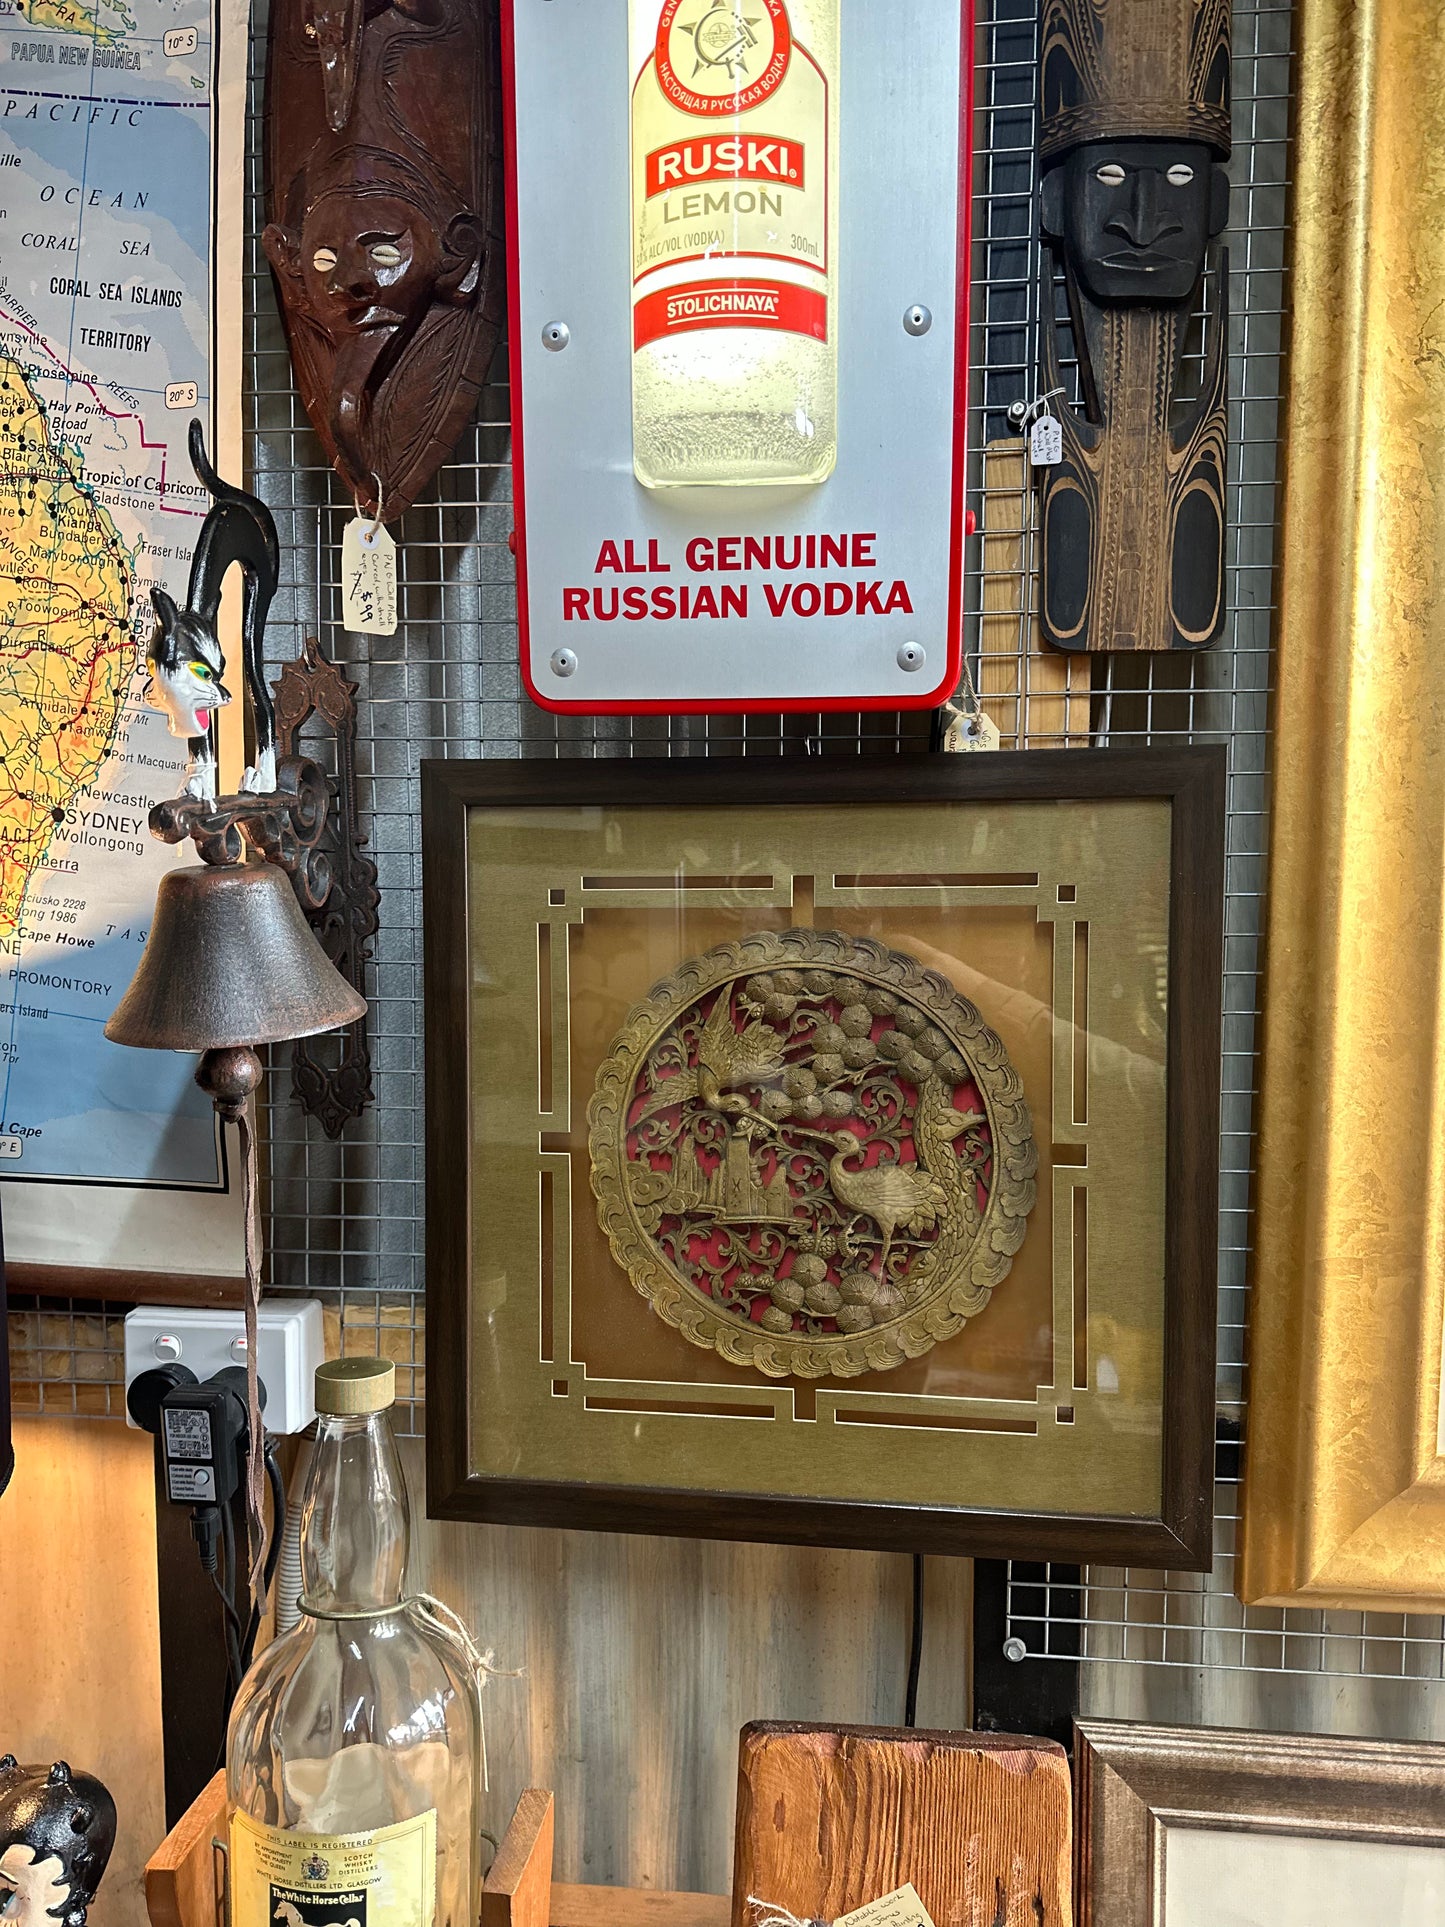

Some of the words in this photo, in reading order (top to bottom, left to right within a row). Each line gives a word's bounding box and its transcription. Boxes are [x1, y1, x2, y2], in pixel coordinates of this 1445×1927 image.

[11, 42, 55, 63] PAPUA
[59, 46, 89, 66] NEW
[93, 48, 141, 71] GUINEA
[660, 62, 707, 110] НАСТОЯЩАЯ
[711, 86, 762, 112] РУССКАЯ
[761, 53, 785, 91] ВОДКА
[4, 100, 143, 127] PACIFIC
[658, 142, 788, 185] RUSKI
[40, 185, 149, 208] OCEAN
[664, 191, 782, 224] LEMON
[21, 232, 78, 251] CORAL
[120, 240, 150, 256] SEA
[790, 233, 819, 258] 300mL
[50, 277, 91, 298] CORAL
[99, 283, 122, 301] SEA
[131, 287, 182, 308] ISLANDS
[667, 295, 775, 318] STOLICHNAYA
[0, 344, 22, 357] Ayr
[80, 328, 151, 353] TERRITORY
[28, 364, 98, 384] Proserpine
[106, 381, 140, 410] REEFS
[49, 400, 71, 415] Hay
[75, 403, 106, 415] Point
[52, 417, 88, 430] Broad
[52, 429, 92, 445] Sound
[3, 448, 31, 460] Blair
[77, 468, 121, 485] Tropic
[125, 475, 141, 487] of
[144, 477, 207, 497] Capricorn
[57, 504, 96, 517] Moura
[93, 490, 155, 511] Gladstone
[58, 515, 102, 533] Kianga
[40, 526, 108, 548] Bundaberg
[29, 545, 114, 569] Maryborough
[142, 541, 172, 558] Fraser
[594, 538, 671, 574] ALL
[685, 533, 876, 572] GENUINE
[24, 576, 58, 591] Roma
[129, 574, 168, 589] Gympie
[17, 598, 97, 620] Toowoomba
[89, 598, 119, 613] Dalby
[563, 584, 748, 621] RUSSIAN
[762, 580, 914, 618] VODKA
[0, 635, 75, 655] Dirranbandi
[19, 697, 78, 716] Armidale
[96, 708, 132, 723] Round
[134, 714, 149, 725] Mt
[67, 720, 130, 743] Tamworth
[111, 750, 135, 764] Port
[137, 754, 188, 773] Macquarie
[25, 790, 79, 807] Bathurst
[81, 784, 156, 809] Newcastle
[66, 809, 143, 835] SYDNEY
[55, 828, 144, 856] Wollongong
[12, 849, 79, 871] Canberra
[7, 890, 59, 906] Kosciusko
[63, 898, 86, 911] 2228
[0, 902, 45, 921] Bogong
[50, 910, 77, 924] 1986
[18, 927, 51, 943] Cape
[55, 932, 96, 948] Howe
[8, 969, 112, 996] PROMONTORY
[19, 1004, 48, 1019] Island
[3, 1053, 20, 1064] Tor
[9, 1122, 42, 1138] Cape
[266, 1833, 280, 1843] THIS
[284, 1839, 307, 1849] LABEL
[322, 1838, 373, 1849] REGISTERED
[261, 1845, 293, 1859] APPOINTMENT
[272, 1855, 293, 1866] MAJESTY
[344, 1853, 373, 1862] SCOTCH
[259, 1857, 268, 1867] THE
[270, 1861, 286, 1871] QUEEN
[338, 1865, 379, 1876] DISTILLERS
[344, 1860, 373, 1868] WHISKY
[255, 1868, 272, 1880] WHITE
[274, 1875, 293, 1887] HORSE
[295, 1880, 327, 1890] DISTILLERS
[347, 1876, 383, 1889] GLASGOW
[272, 1887, 286, 1899] The
[286, 1891, 312, 1904] White
[312, 1895, 338, 1905] Horse
[339, 1894, 365, 1906] Cellar
[880, 1893, 904, 1909] work
[871, 1910, 901, 1926] James
